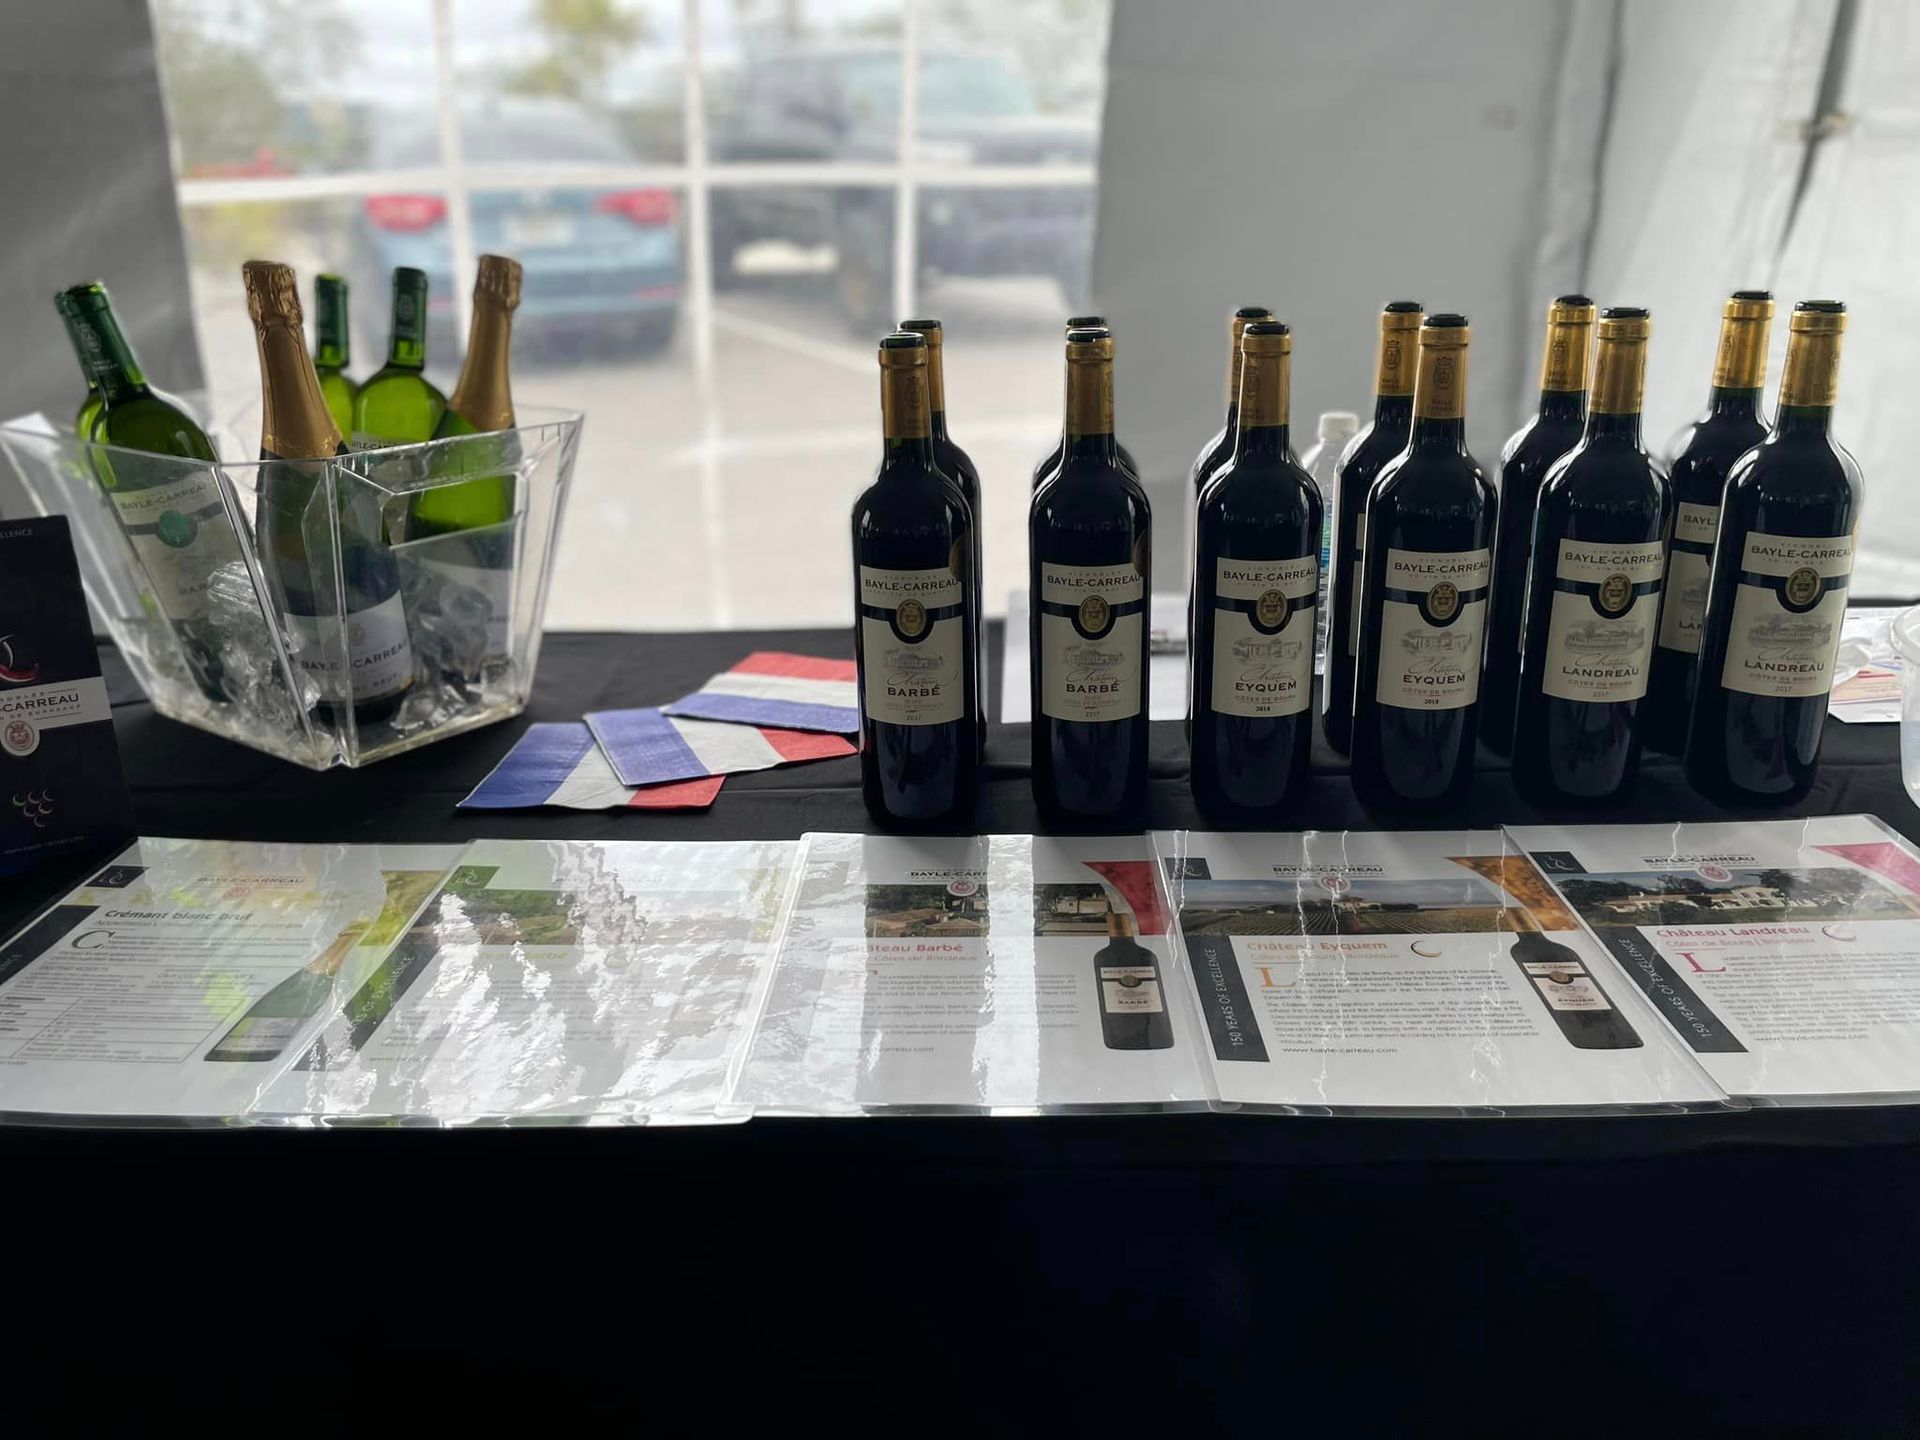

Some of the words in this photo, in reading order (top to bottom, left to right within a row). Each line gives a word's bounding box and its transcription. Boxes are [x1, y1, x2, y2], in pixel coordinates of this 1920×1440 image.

[1394, 559, 1489, 573] BAYLE-CARREAU
[865, 578, 959, 591] BAYLE-CARREAU
[1047, 574, 1141, 587] BAYLE-CARREAU
[1562, 665, 1640, 678] LANDREAU
[1744, 660, 1825, 673] LANDREAU
[1403, 674, 1466, 685] EYQUEM
[887, 685, 941, 697] BARBÉ
[1066, 681, 1120, 693] BARBÉ
[1235, 681, 1297, 692] EYQUEM
[105, 909, 169, 920] Crémant
[171, 911, 216, 920] blanc
[1656, 927, 1726, 937] Château
[1731, 925, 1810, 936] Landreau
[915, 942, 964, 952] Barbé
[1320, 941, 1388, 952] Eyquem
[1204, 947, 1227, 992] EXCELLENCE
[1217, 992, 1231, 1005] OF
[1668, 996, 1698, 1021] YEARS
[1221, 1005, 1239, 1030] YEARS
[1692, 1022, 1713, 1037] 150
[1229, 1031, 1245, 1047] 150
